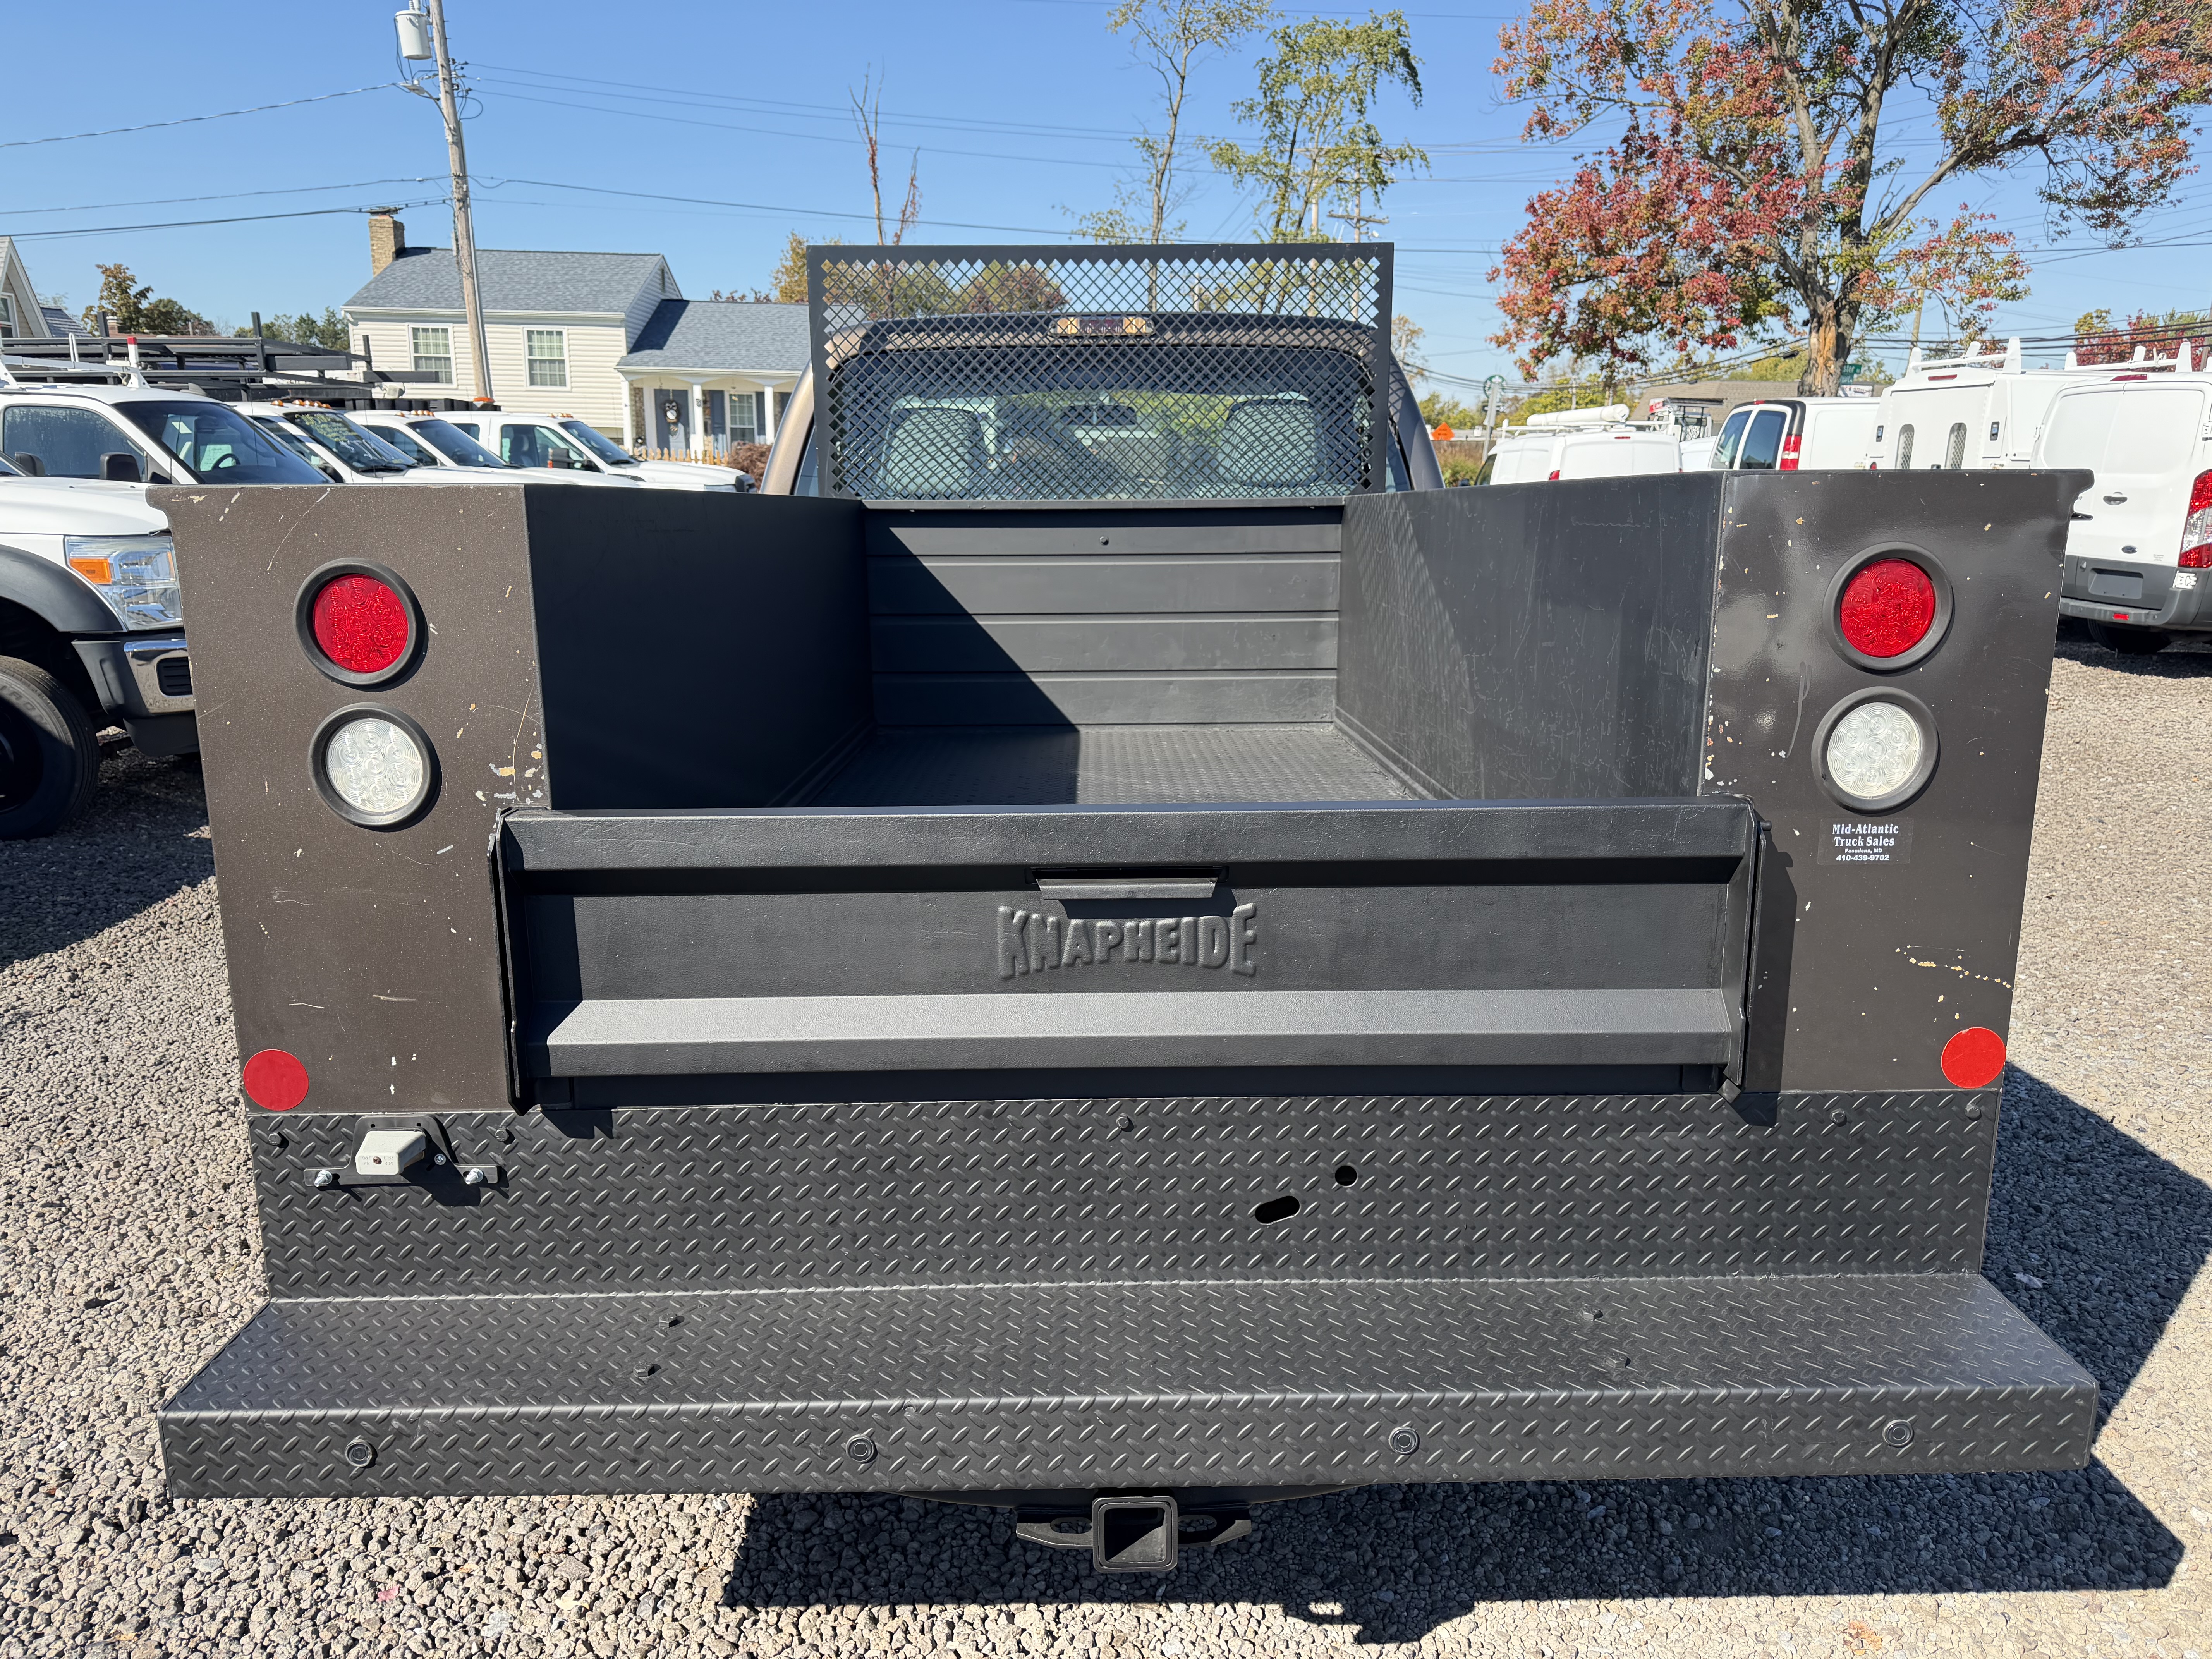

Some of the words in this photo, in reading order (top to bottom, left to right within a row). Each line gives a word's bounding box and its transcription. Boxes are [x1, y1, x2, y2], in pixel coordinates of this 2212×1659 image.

[1832, 824, 1899, 834] Mid-Atlantic
[1834, 836, 1864, 846] Truck
[1866, 836, 1894, 846] Sales
[998, 903, 1257, 980] KNAPHEIDE
